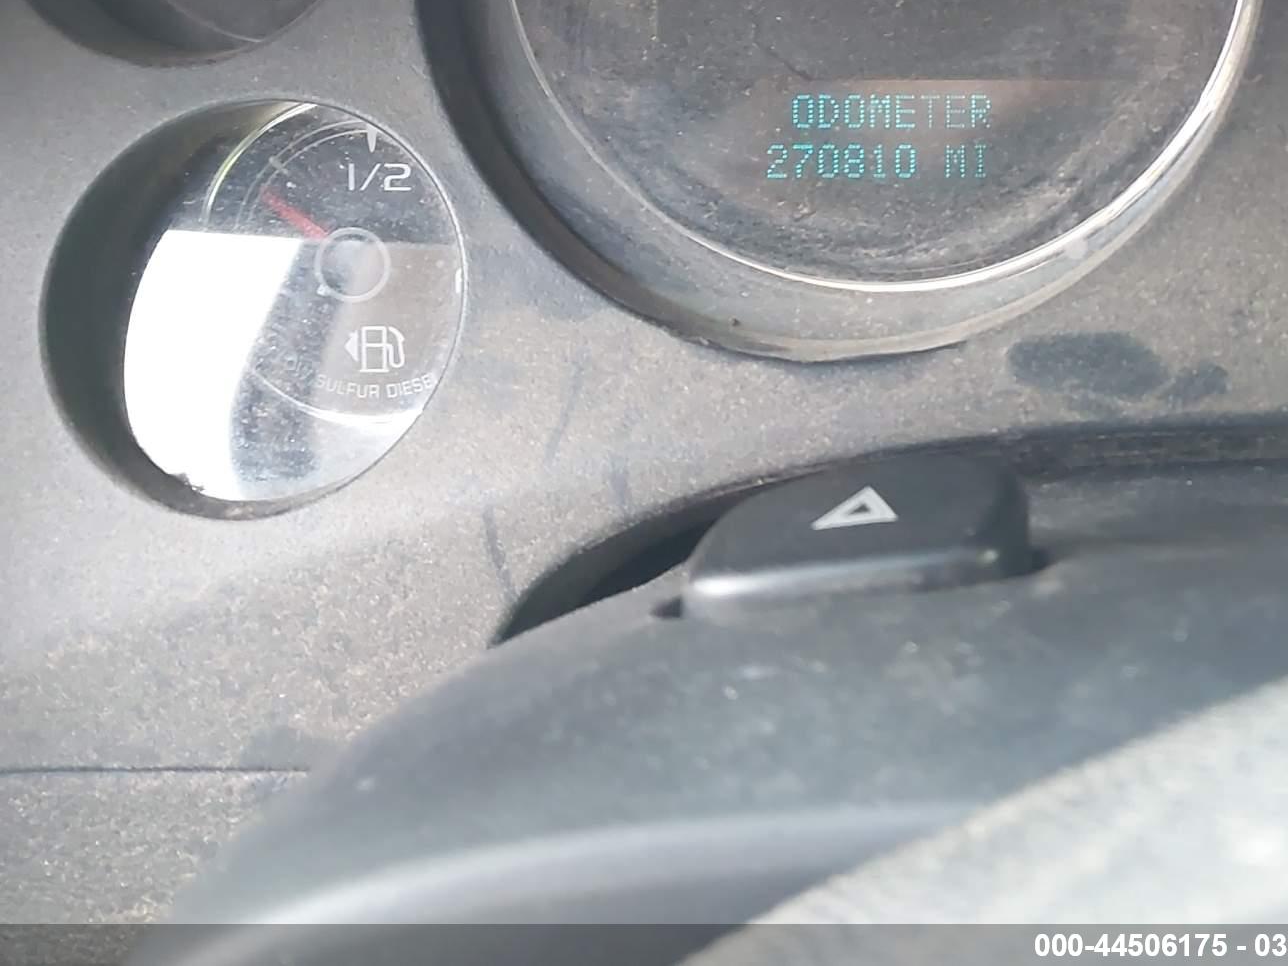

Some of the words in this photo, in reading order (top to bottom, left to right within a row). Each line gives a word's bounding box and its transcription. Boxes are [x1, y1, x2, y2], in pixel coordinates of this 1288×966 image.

[791, 92, 992, 130] ODOMETER
[346, 162, 412, 192] 1/2
[766, 143, 917, 179] 270810
[945, 143, 987, 179] MI
[315, 373, 380, 399] SULFUR
[385, 372, 437, 399] DIESE
